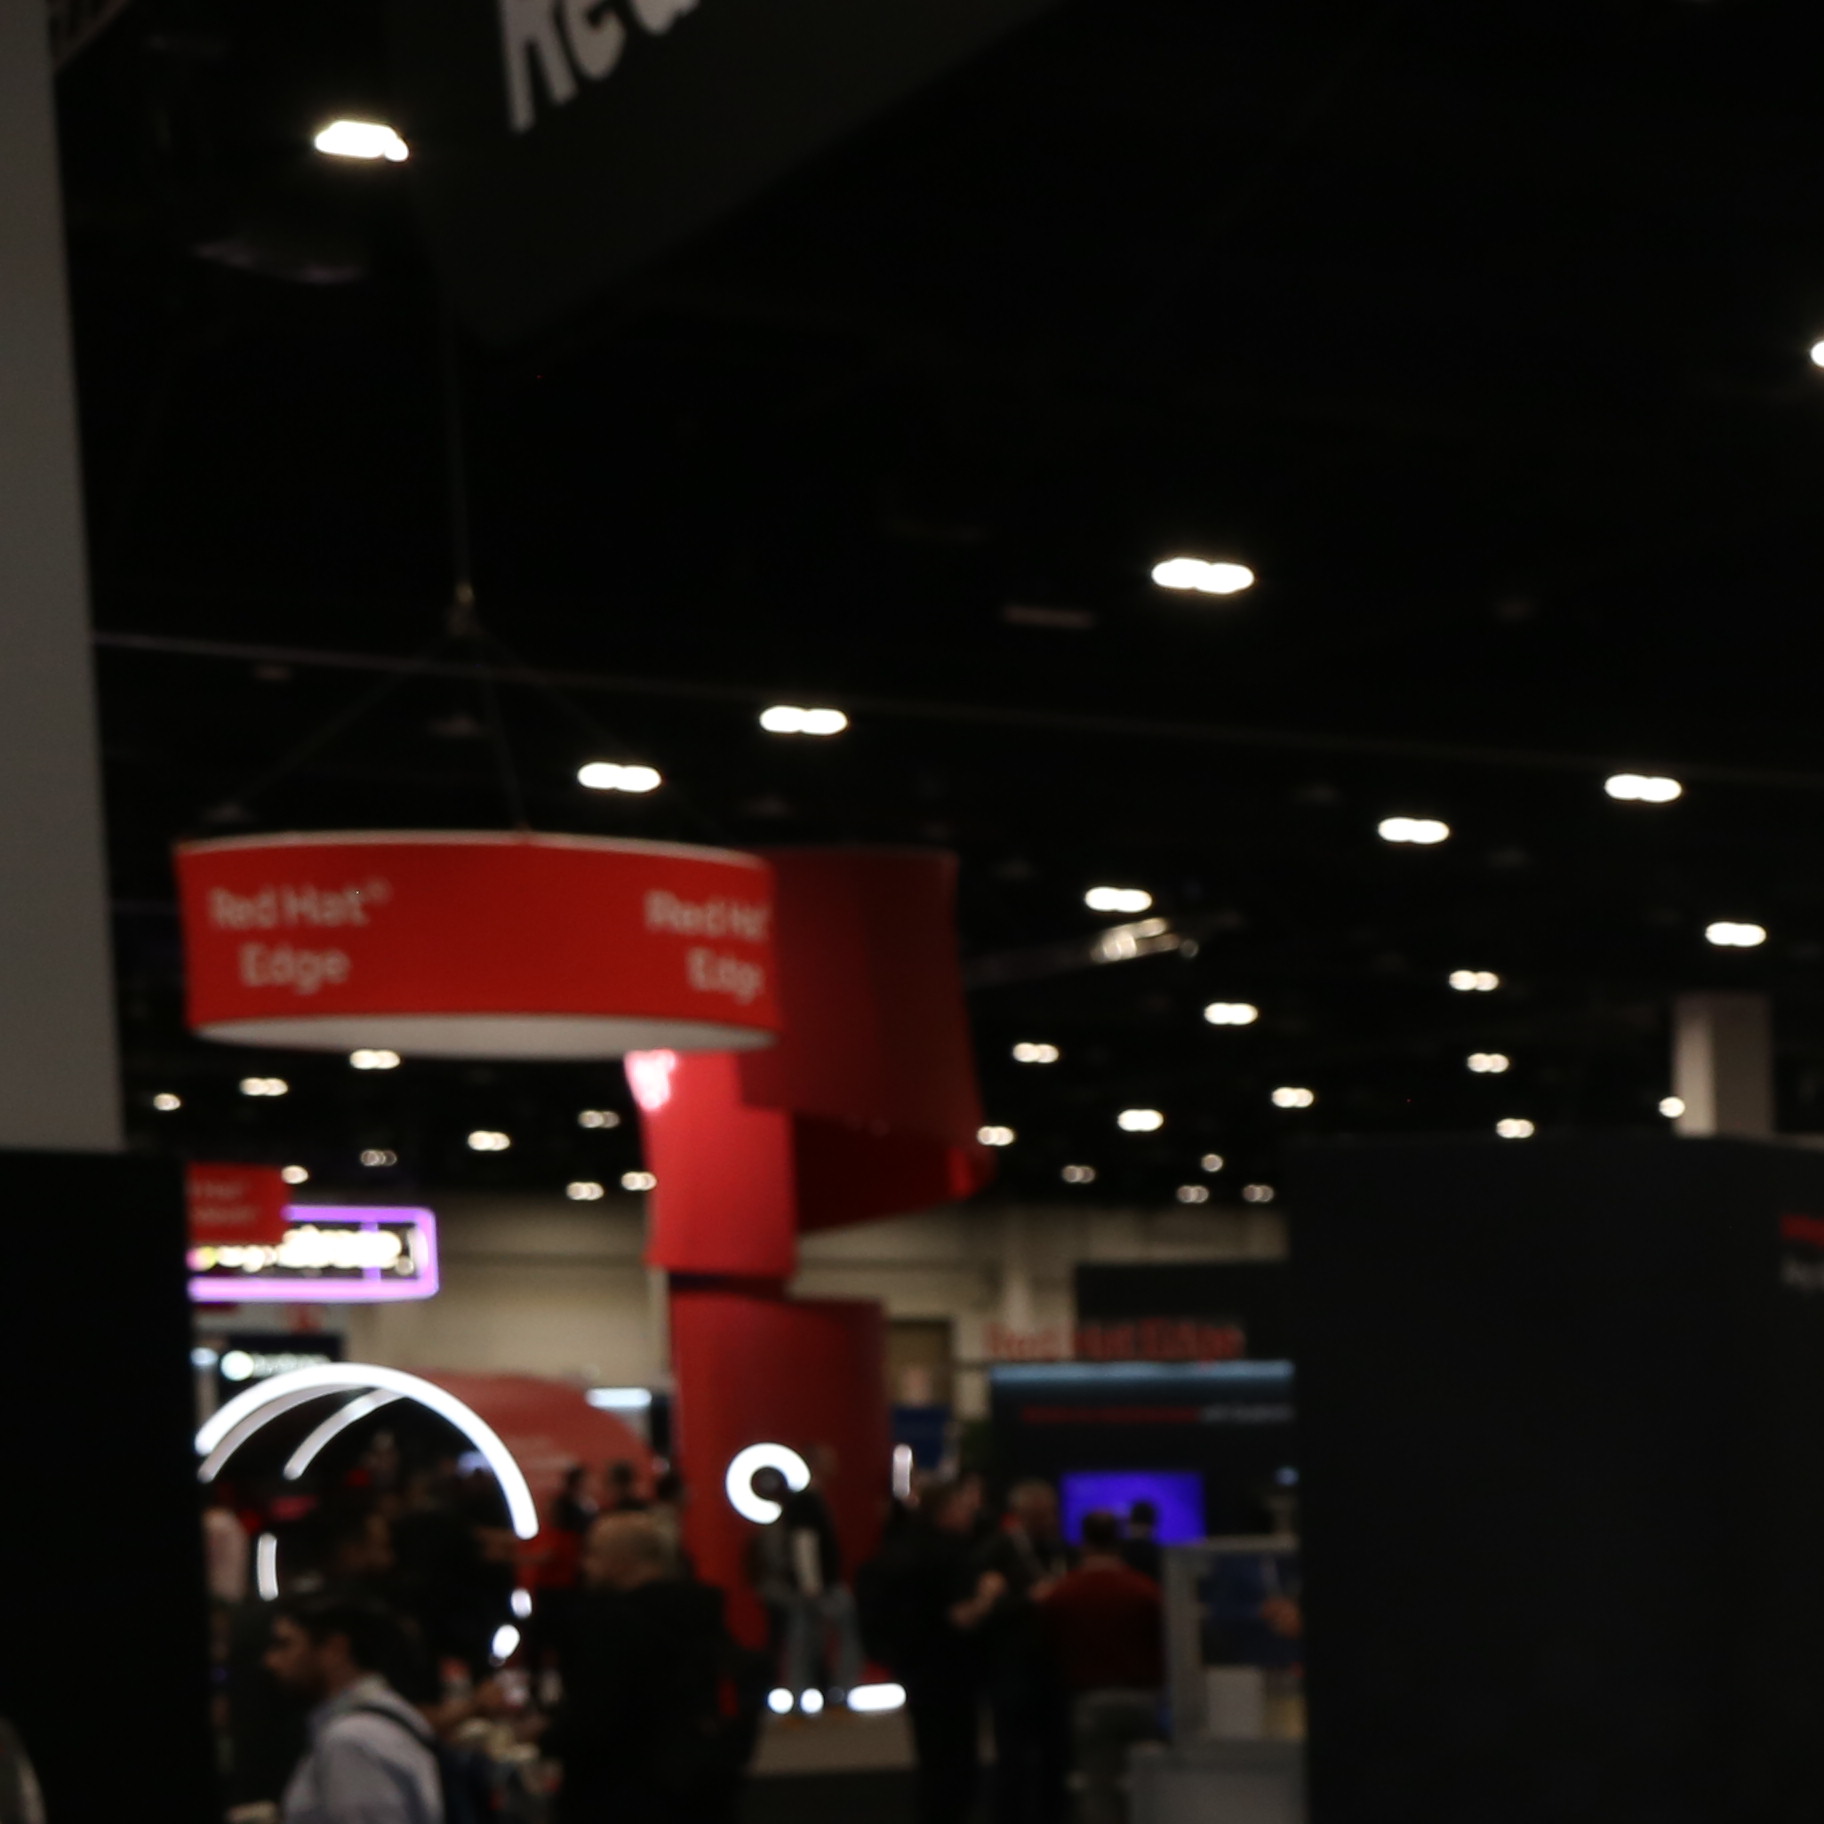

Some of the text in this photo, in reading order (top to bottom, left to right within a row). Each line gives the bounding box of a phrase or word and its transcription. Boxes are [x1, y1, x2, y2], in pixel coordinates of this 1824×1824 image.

[207, 884, 279, 931] Red
[643, 887, 728, 938] Red
[239, 941, 352, 997] Edge
